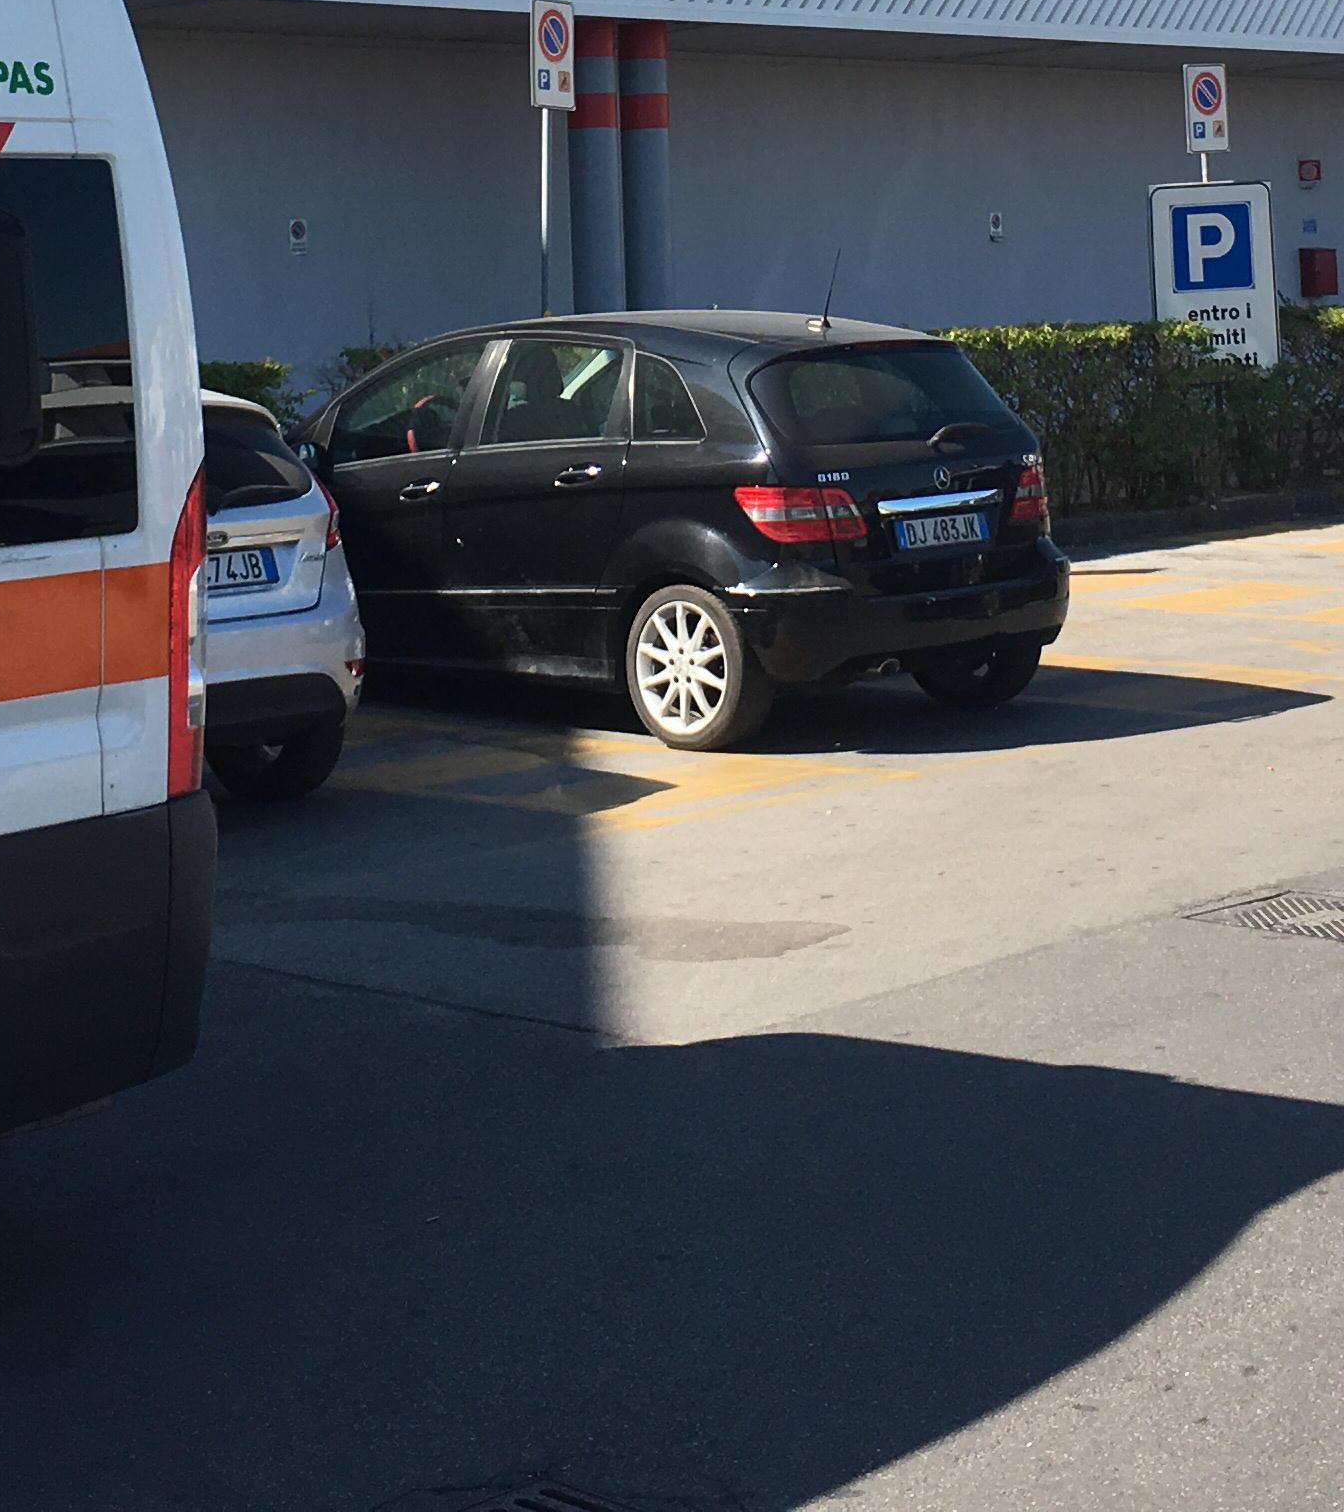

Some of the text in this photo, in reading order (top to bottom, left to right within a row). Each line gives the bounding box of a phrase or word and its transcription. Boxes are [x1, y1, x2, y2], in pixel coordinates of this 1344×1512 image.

[1187, 213, 1235, 282] P
[1188, 302, 1252, 322] entro i
[1209, 328, 1246, 346] miti
[207, 553, 263, 583] 74JB
